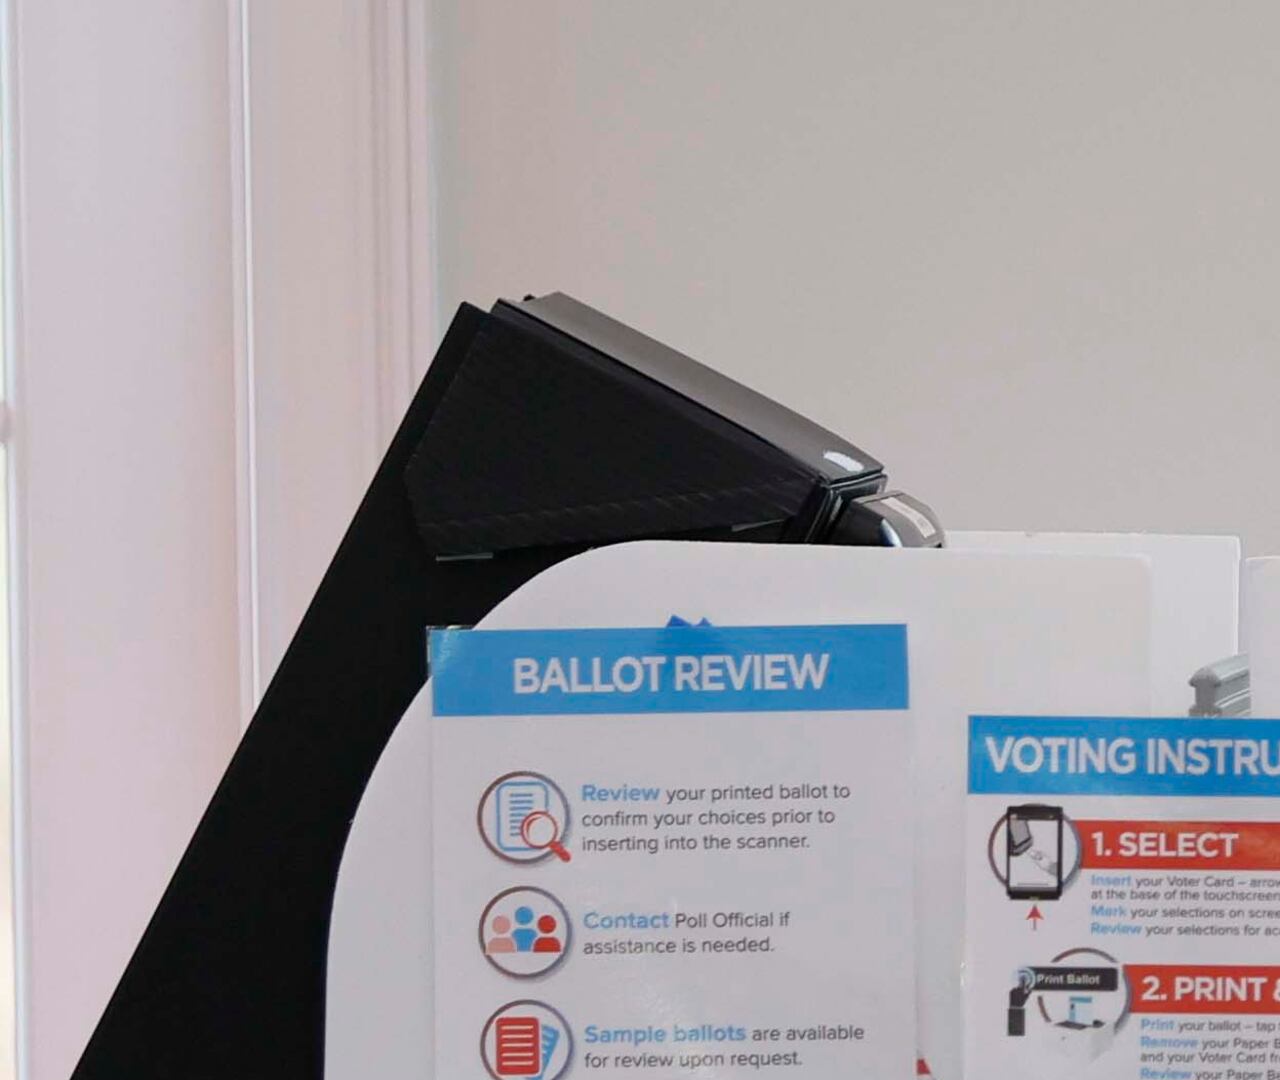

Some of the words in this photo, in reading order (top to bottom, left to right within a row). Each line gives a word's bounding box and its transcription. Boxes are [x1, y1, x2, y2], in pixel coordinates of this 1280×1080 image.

[513, 655, 667, 694] BALLOT
[674, 652, 830, 692] REVIEW
[985, 735, 1136, 775] VOTING
[581, 784, 660, 802] Review
[666, 788, 706, 805] your
[711, 784, 773, 803] printed
[780, 784, 828, 800] ballot
[833, 784, 851, 798] to
[582, 810, 647, 828] confirm
[653, 813, 693, 830] your
[698, 809, 766, 826] choices
[772, 808, 813, 827] prior
[818, 809, 835, 824] to
[582, 836, 658, 855] inserting
[665, 836, 697, 851] into
[703, 835, 731, 850] the
[737, 836, 809, 849] scanner.
[1092, 831, 1112, 856] 1.
[1119, 831, 1239, 858] SELECT
[583, 911, 670, 930] Contact
[675, 912, 707, 929] Poll
[713, 911, 773, 929] Official
[780, 911, 790, 926] if
[1145, 925, 1174, 937] your
[1177, 923, 1240, 936] selections
[1244, 924, 1261, 936] for
[583, 939, 676, 955] assistance
[683, 938, 696, 954] is
[702, 936, 774, 953] needed.
[1036, 973, 1064, 984] Print
[1067, 973, 1100, 985] Ballot
[1141, 975, 1167, 1001] 2.
[1174, 975, 1268, 1002] PRINT
[584, 1024, 667, 1047] Sample
[674, 1024, 747, 1042] ballots
[752, 1028, 781, 1042] are
[786, 1024, 864, 1041] available
[584, 1052, 609, 1069] for
[615, 1052, 673, 1068] review
[680, 1054, 724, 1070] upon
[731, 1051, 802, 1069] request.
